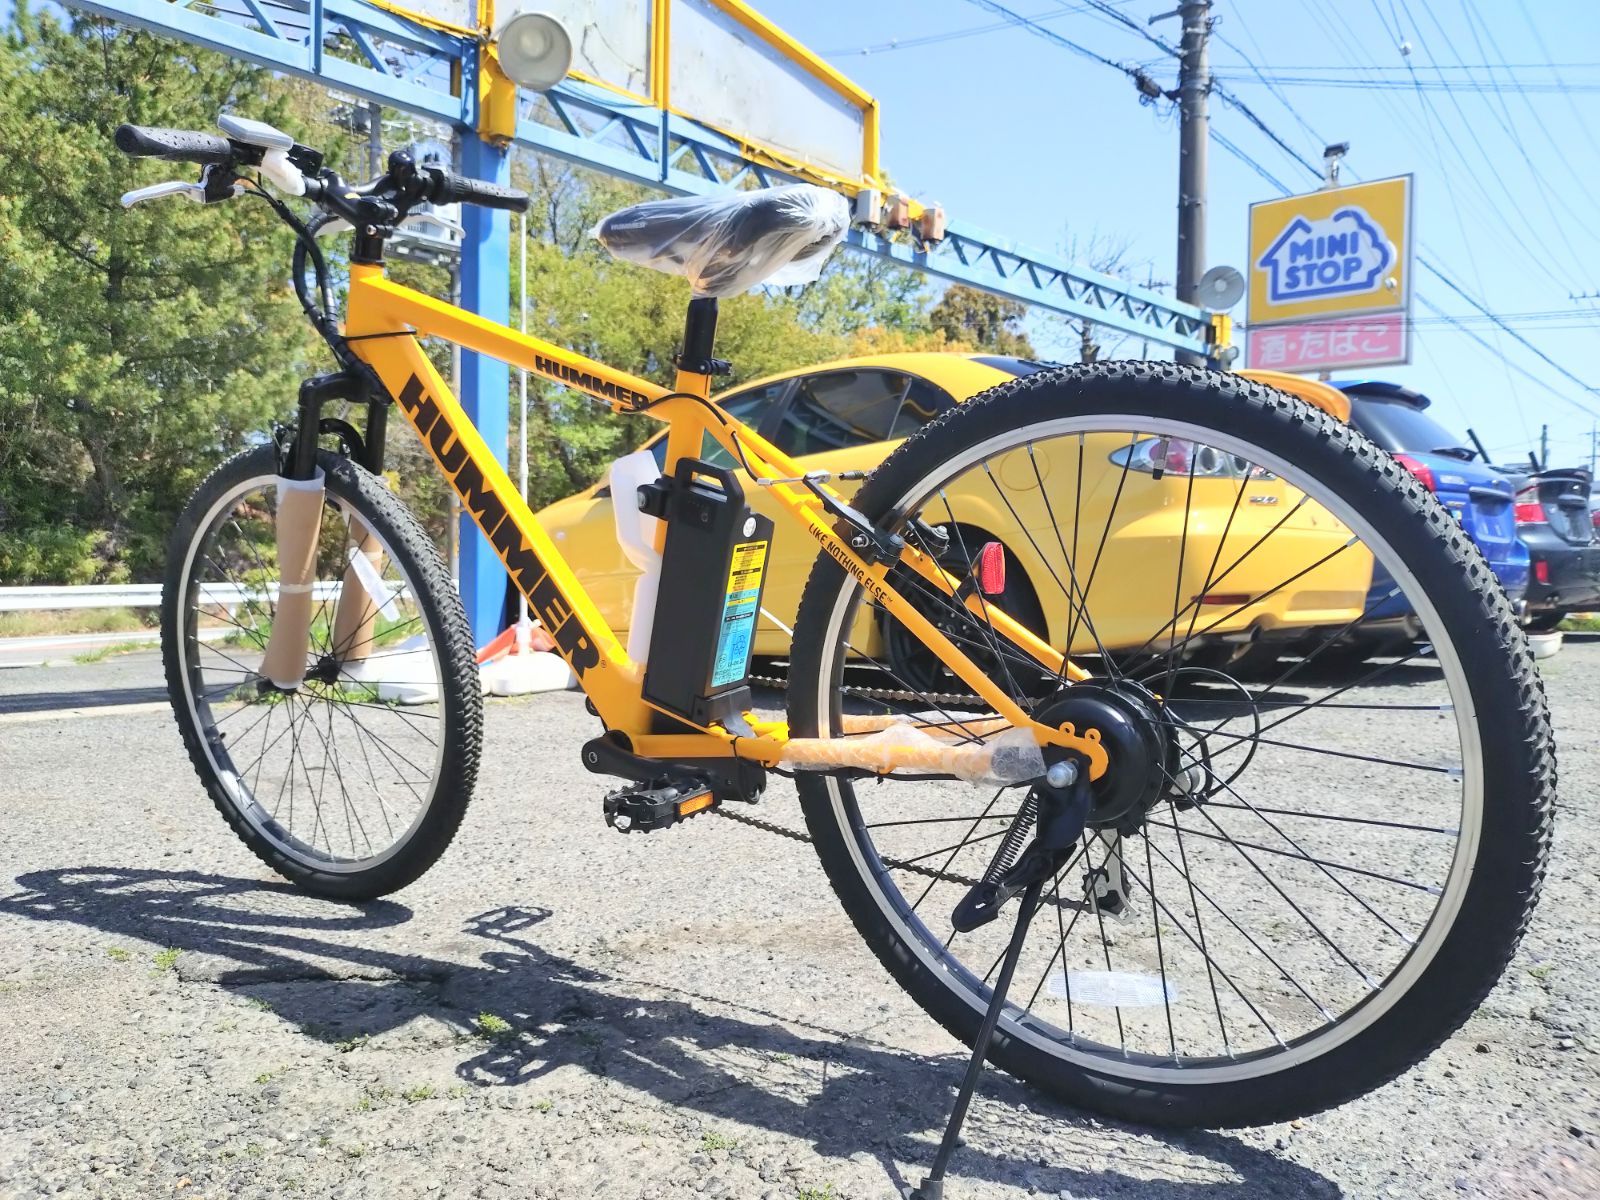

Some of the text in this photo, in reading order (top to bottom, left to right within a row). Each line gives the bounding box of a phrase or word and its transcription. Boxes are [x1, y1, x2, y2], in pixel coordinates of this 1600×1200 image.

[1289, 231, 1359, 263] MINI
[1285, 257, 1362, 290] STOP
[399, 373, 599, 680] HUMMER
[808, 523, 828, 545] LIKE
[826, 541, 864, 582] NOTHING
